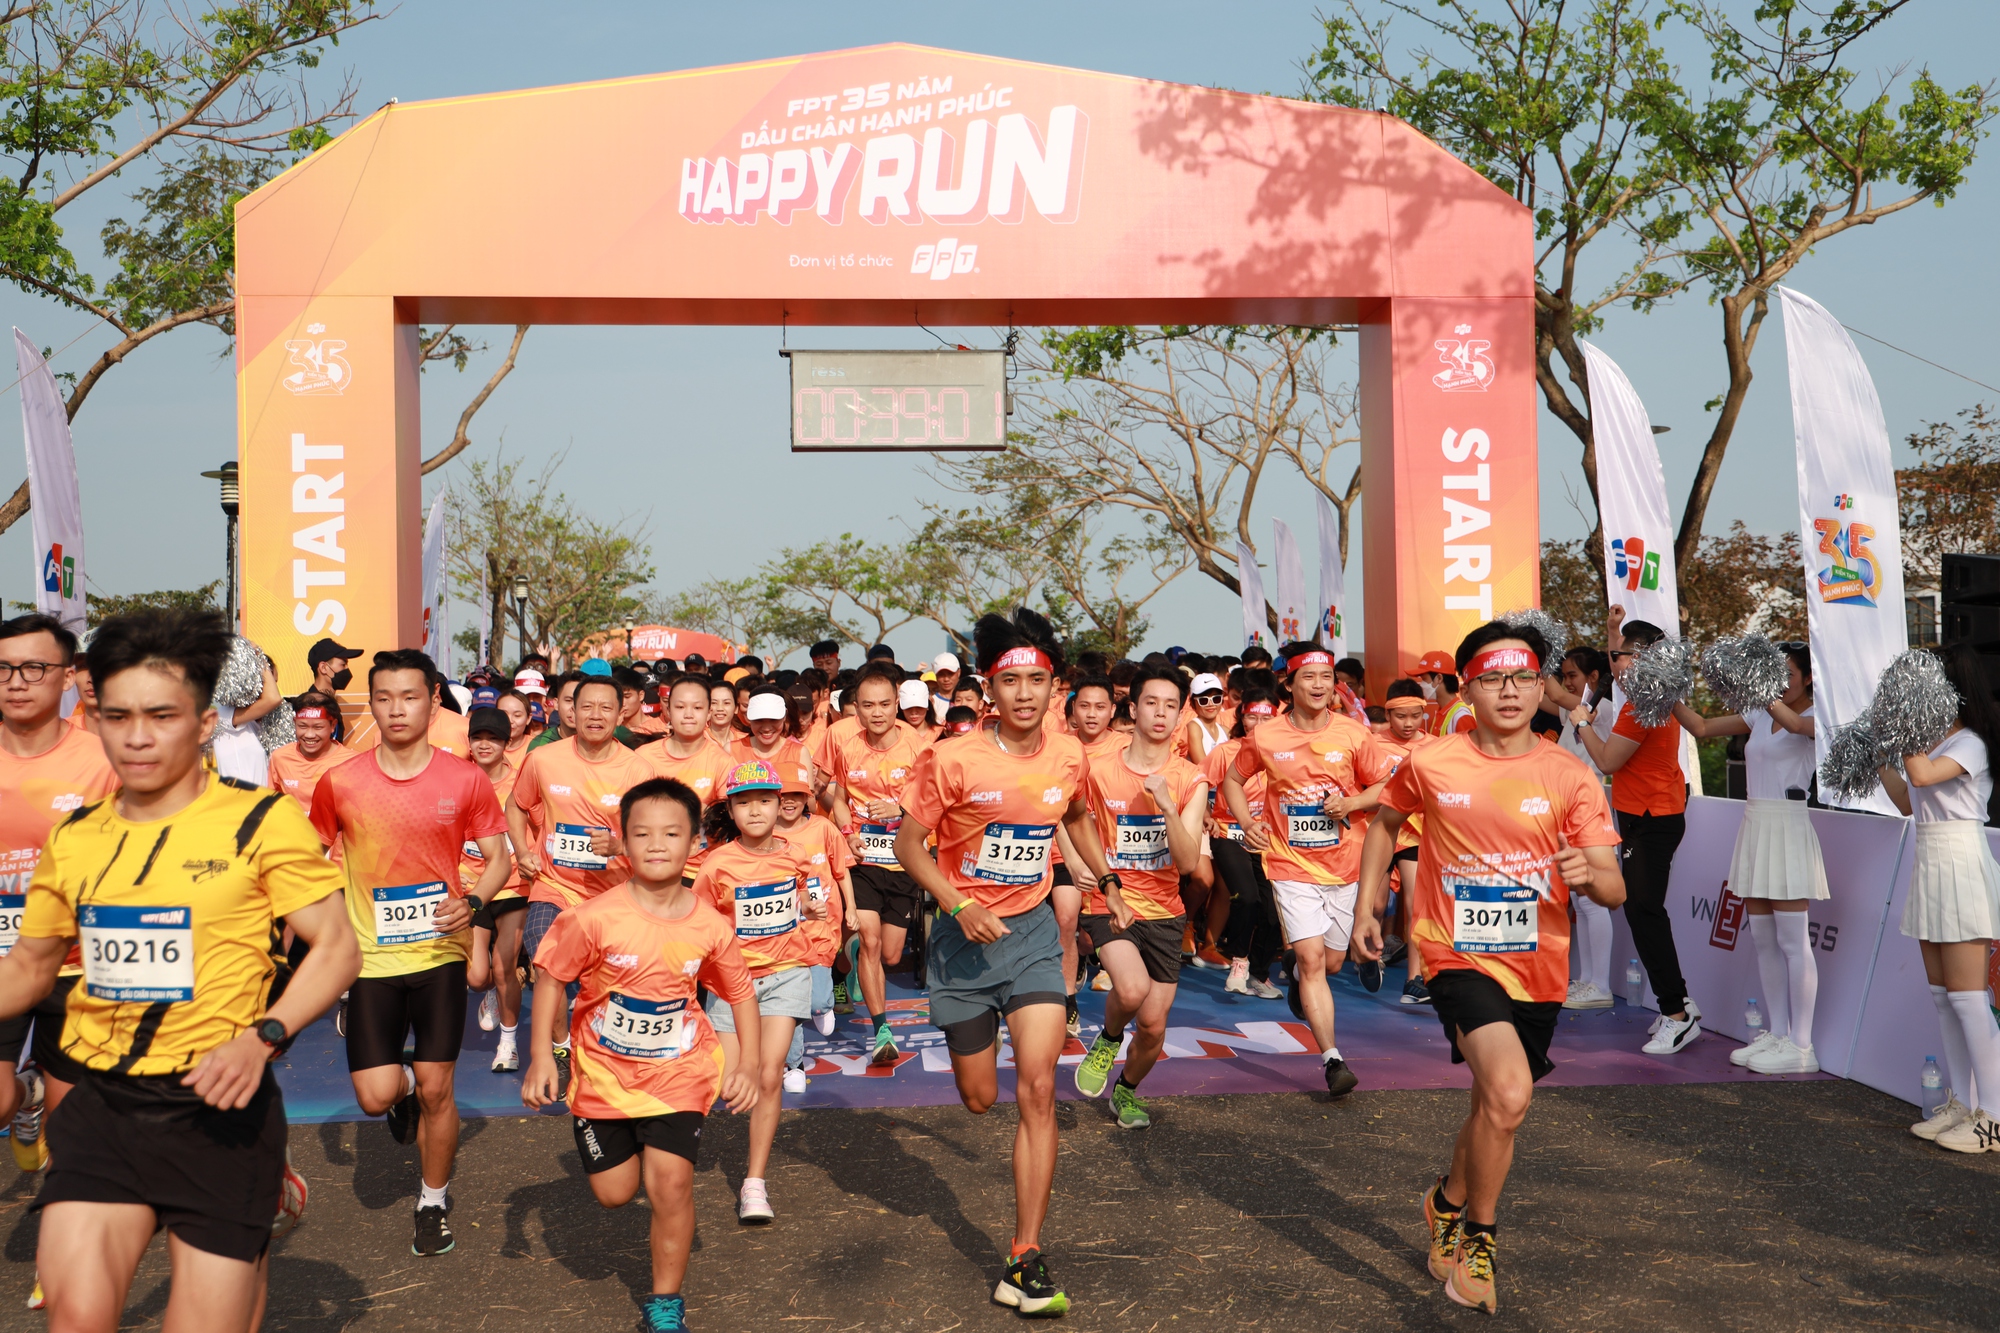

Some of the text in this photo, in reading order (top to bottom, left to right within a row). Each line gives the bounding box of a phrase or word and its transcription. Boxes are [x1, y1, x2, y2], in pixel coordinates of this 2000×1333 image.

[787, 76, 953, 117] FPT 35 NĂM
[741, 84, 1013, 149] DẤU CHÂN HẠNH PHÚC
[789, 253, 893, 270] Đơn vị tổ chức
[910, 238, 978, 280] FPT
[283, 340, 352, 393] 35
[1432, 339, 1495, 391] 35
[1834, 494, 1853, 510] FPT
[1441, 427, 1492, 621] START
[291, 433, 347, 636] START
[1611, 537, 1661, 592] FPT
[1814, 518, 1883, 601] 35
[1823, 582, 1860, 599] HẠNH PHÚC
[648, 633, 677, 649] RUN
[1012, 652, 1036, 665] RUN
[1314, 655, 1328, 664] RUN
[1483, 656, 1503, 669] HAPPY
[1503, 652, 1528, 666] RUN
[1273, 751, 1295, 759] HOPE
[550, 784, 572, 794] HOPE
[970, 790, 1003, 802] HOPE
[1042, 786, 1062, 805] FPT
[52, 793, 84, 812] FPT
[1437, 792, 1471, 805] HOPE
[1519, 797, 1550, 816] FPT
[1293, 819, 1334, 831] 30028
[1123, 829, 1167, 843] 30479
[560, 838, 594, 853] 3136
[988, 843, 1044, 861] 31253
[9, 848, 34, 861] 35
[1481, 852, 1503, 864] 35
[1505, 851, 1532, 863] NĂM
[428, 883, 443, 893] RUN
[1516, 889, 1533, 898] RUN
[383, 900, 441, 922] 30217
[743, 897, 792, 917] 30524
[158, 910, 185, 925] RUN
[1463, 908, 1528, 927] 30714
[92, 938, 180, 963] 30216
[1461, 943, 1469, 951] FPT
[613, 1011, 674, 1036] 31353
[583, 1126, 605, 1161] YONEX
